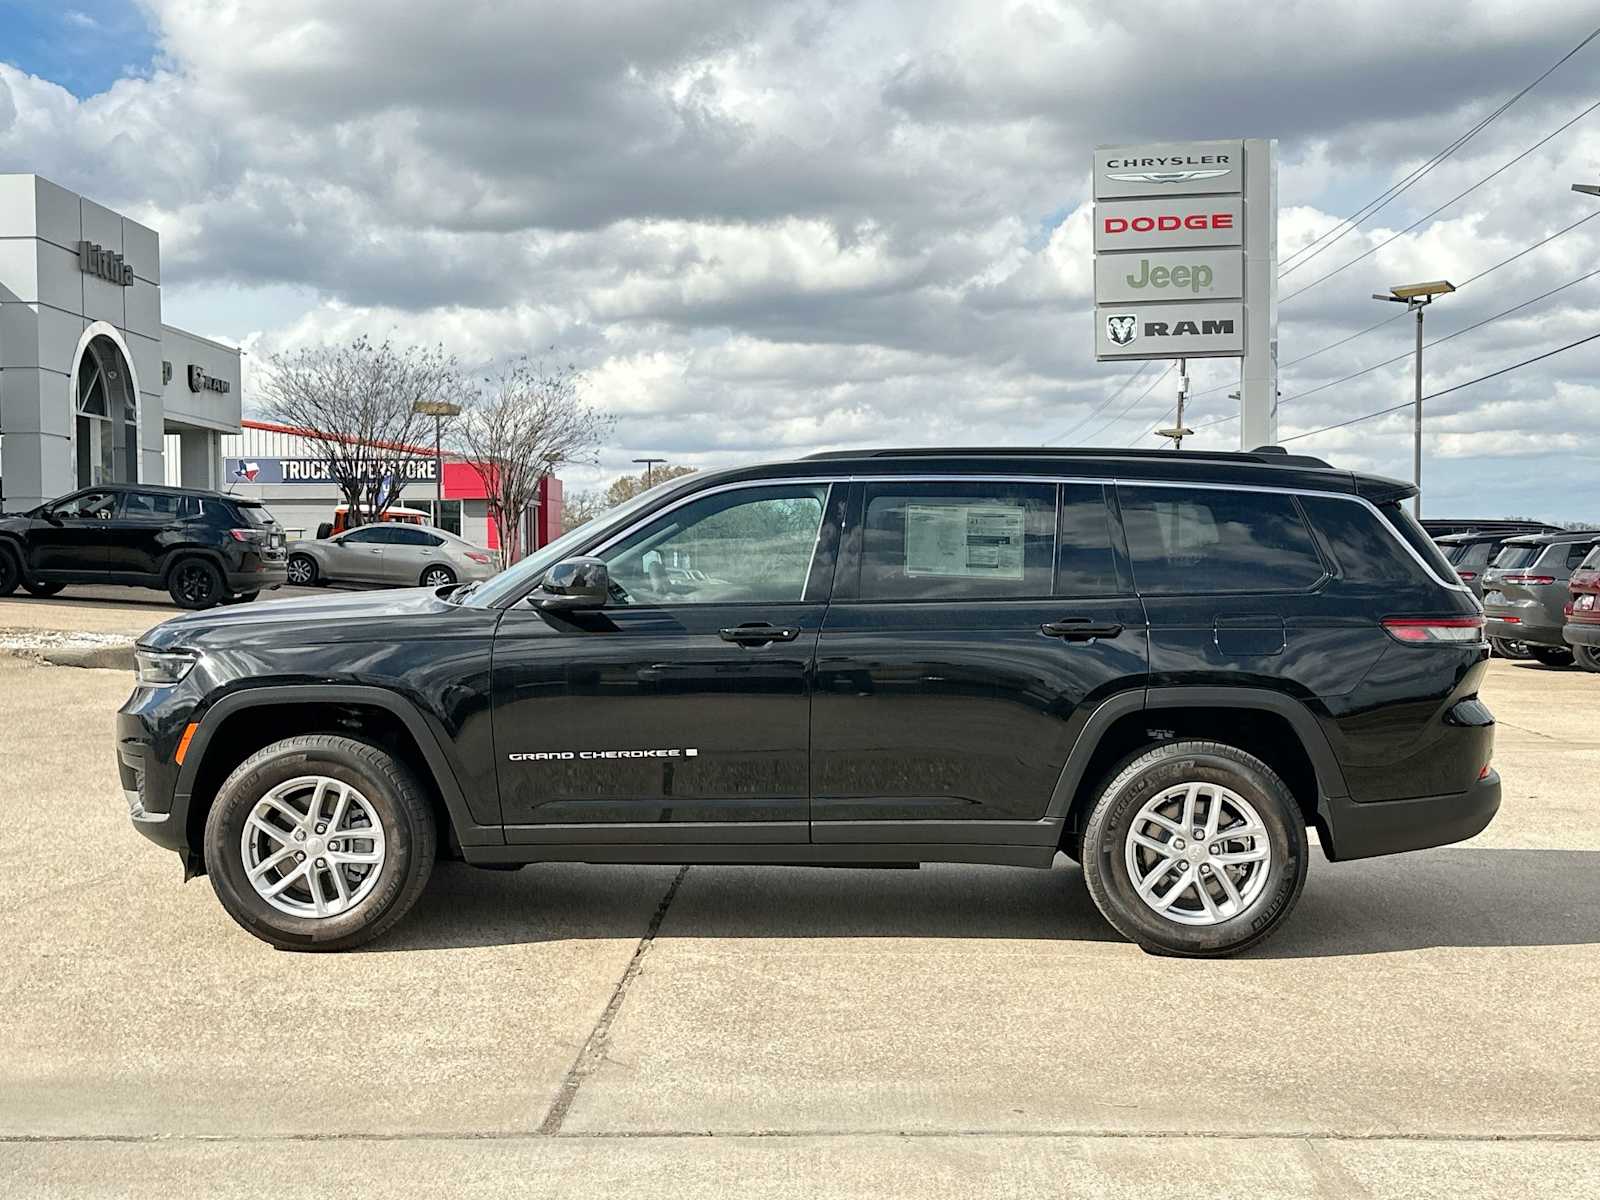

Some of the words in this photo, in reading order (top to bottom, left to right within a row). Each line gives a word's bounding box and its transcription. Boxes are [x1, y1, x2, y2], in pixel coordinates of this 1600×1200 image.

[1106, 155, 1230, 168] CHRYSLER
[1105, 214, 1233, 234] DODGE
[79, 240, 133, 286] Lithia
[1126, 259, 1213, 293] Jeep
[1144, 320, 1234, 337] RAM
[280, 460, 331, 479] TRUCK
[508, 751, 575, 761] GRAND
[579, 749, 681, 760] CHEROKEE
